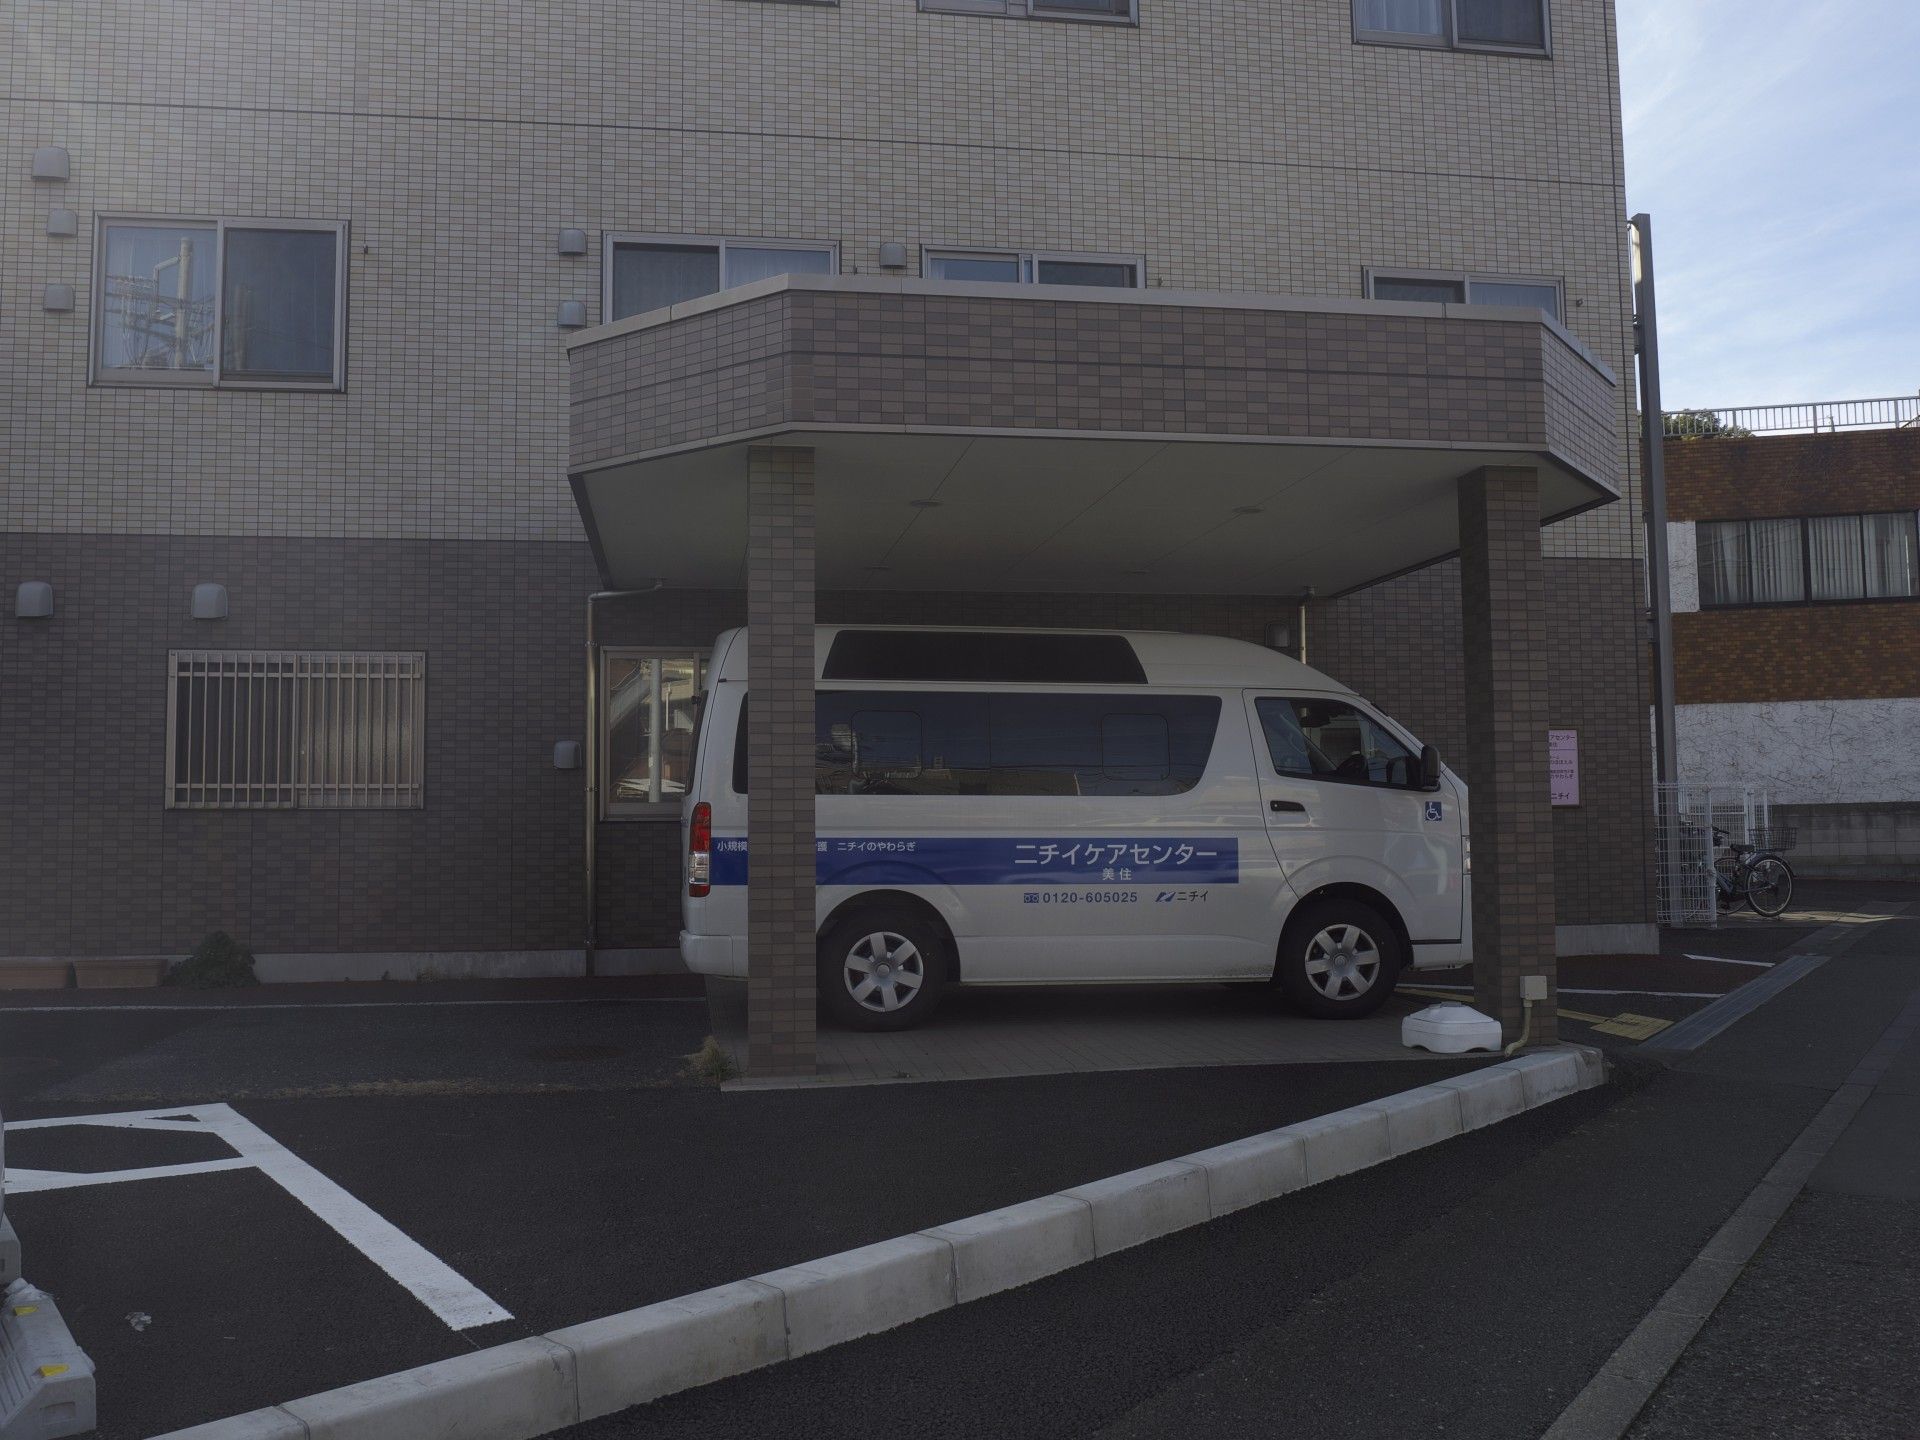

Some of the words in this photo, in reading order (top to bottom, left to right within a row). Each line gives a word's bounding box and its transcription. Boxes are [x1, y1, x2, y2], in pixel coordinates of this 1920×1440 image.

[837, 841, 916, 852] ニチイのやわらぎ
[1014, 843, 1217, 865] ニチイケアセンター
[1102, 868, 1132, 881] 美住
[1042, 892, 1138, 904] 0120-605025
[1176, 890, 1208, 903] ニチイ
